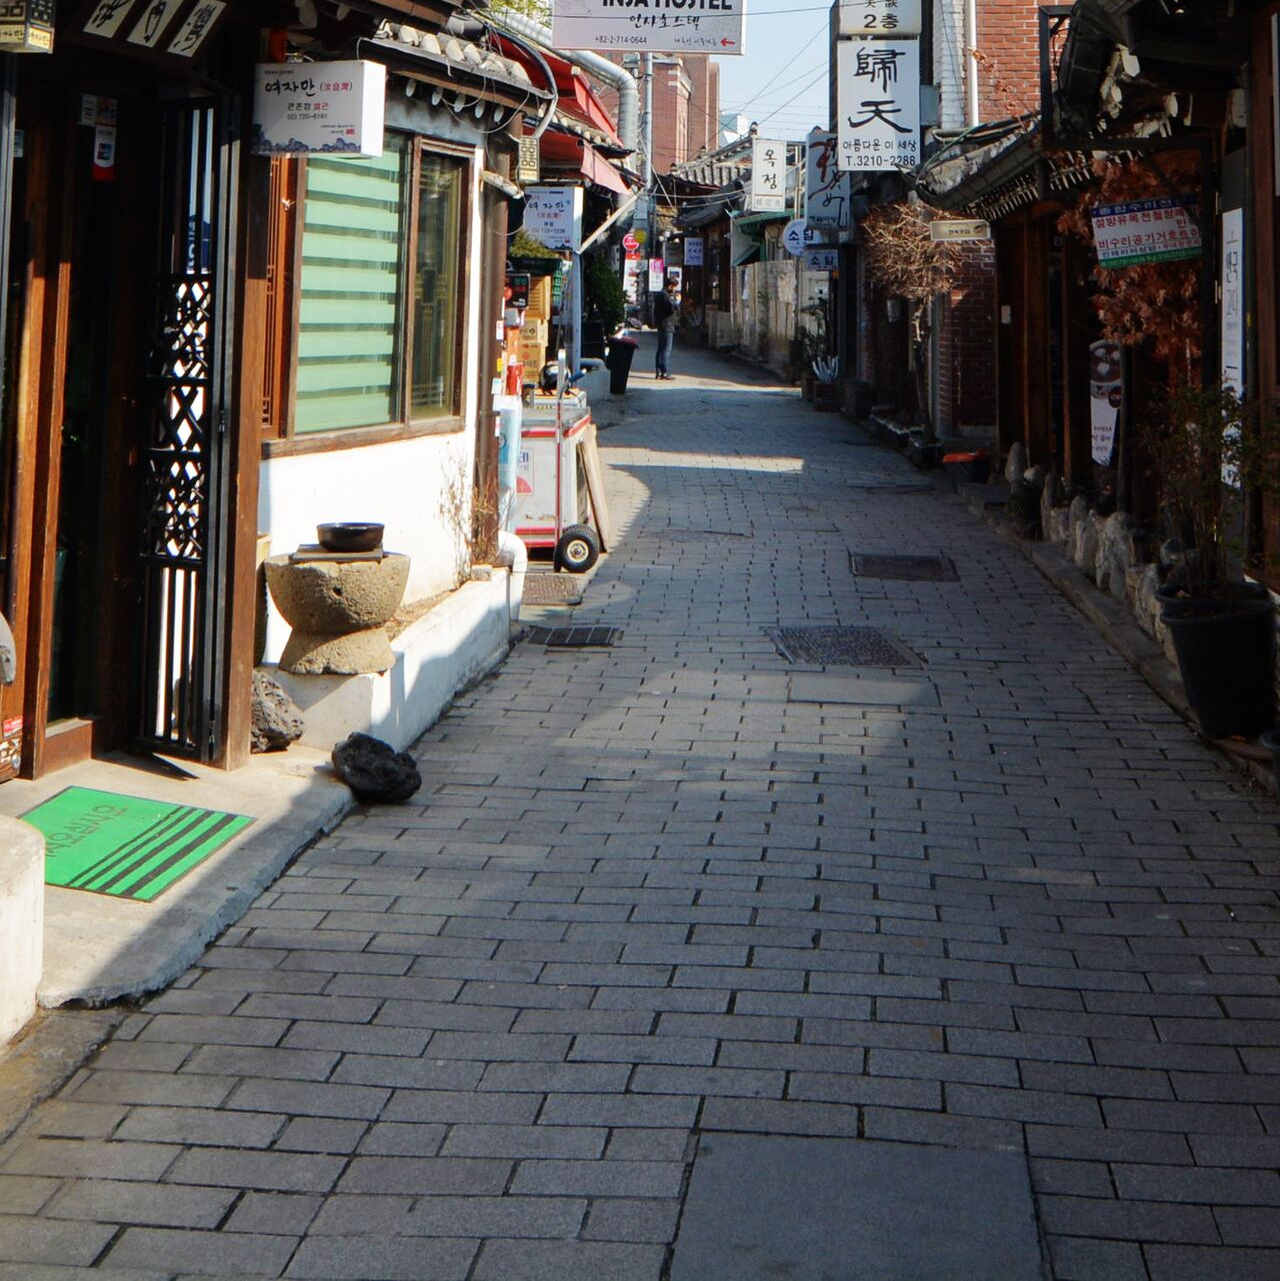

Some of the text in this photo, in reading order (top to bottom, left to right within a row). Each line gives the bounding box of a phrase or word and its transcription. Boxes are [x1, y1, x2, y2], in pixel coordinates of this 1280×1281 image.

[629, 13, 700, 31] 인사호스텔
[864, 13, 900, 29] 2층
[595, 36, 647, 44] +82-2-714-0644
[265, 77, 315, 97] 여자만
[846, 155, 916, 166] T.3210-2288
[528, 200, 564, 213] 여자만
